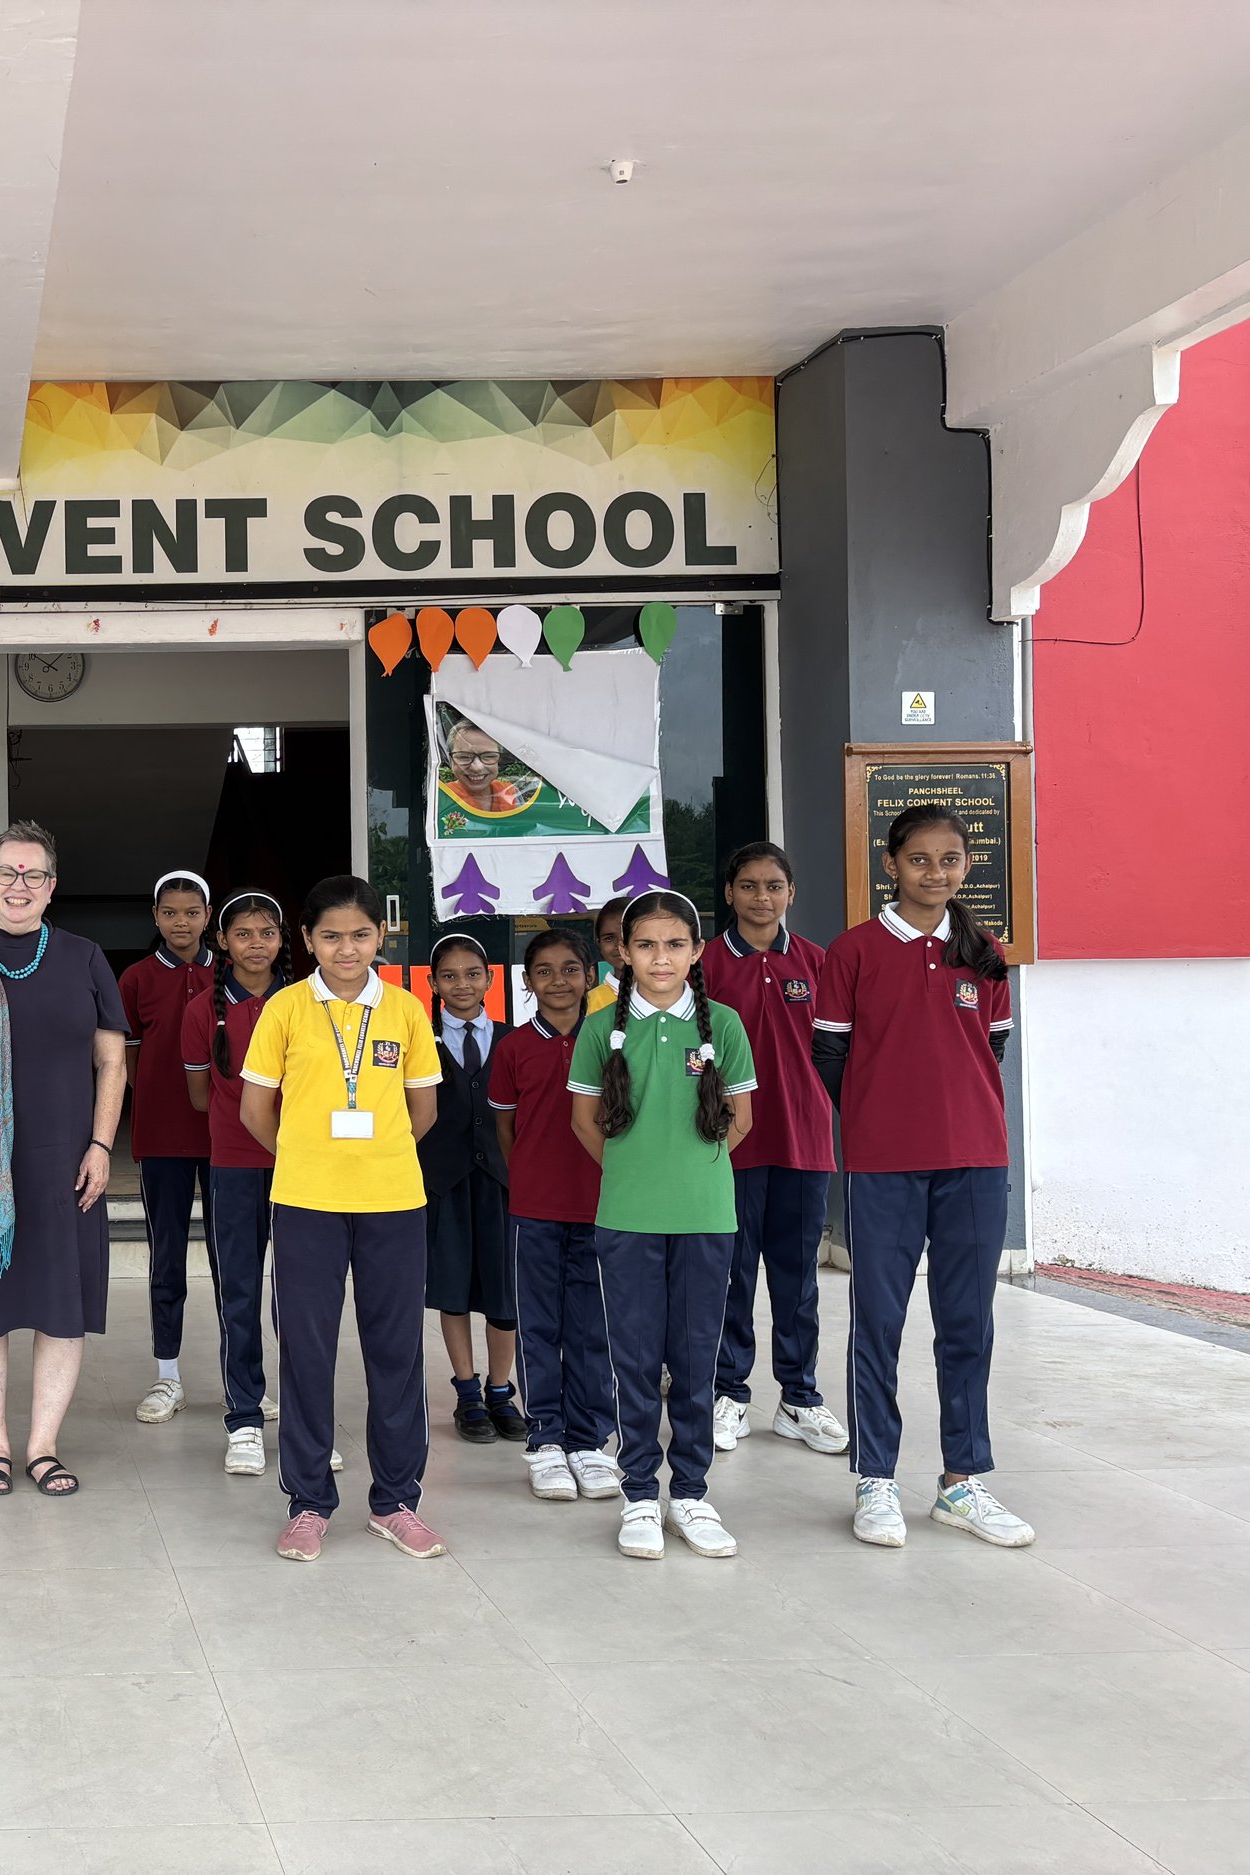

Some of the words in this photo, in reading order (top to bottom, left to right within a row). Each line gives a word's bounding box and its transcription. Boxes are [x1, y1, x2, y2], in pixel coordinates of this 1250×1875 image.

[303, 491, 738, 574] SCHOOL
[914, 773, 930, 782] glory
[908, 787, 963, 795] PANCHSHEEL
[877, 799, 904, 808] FELIX
[906, 798, 952, 807] CONVENT
[954, 797, 996, 807] SCHOOL
[966, 822, 984, 833] utt
[875, 883, 892, 891] Shri.
